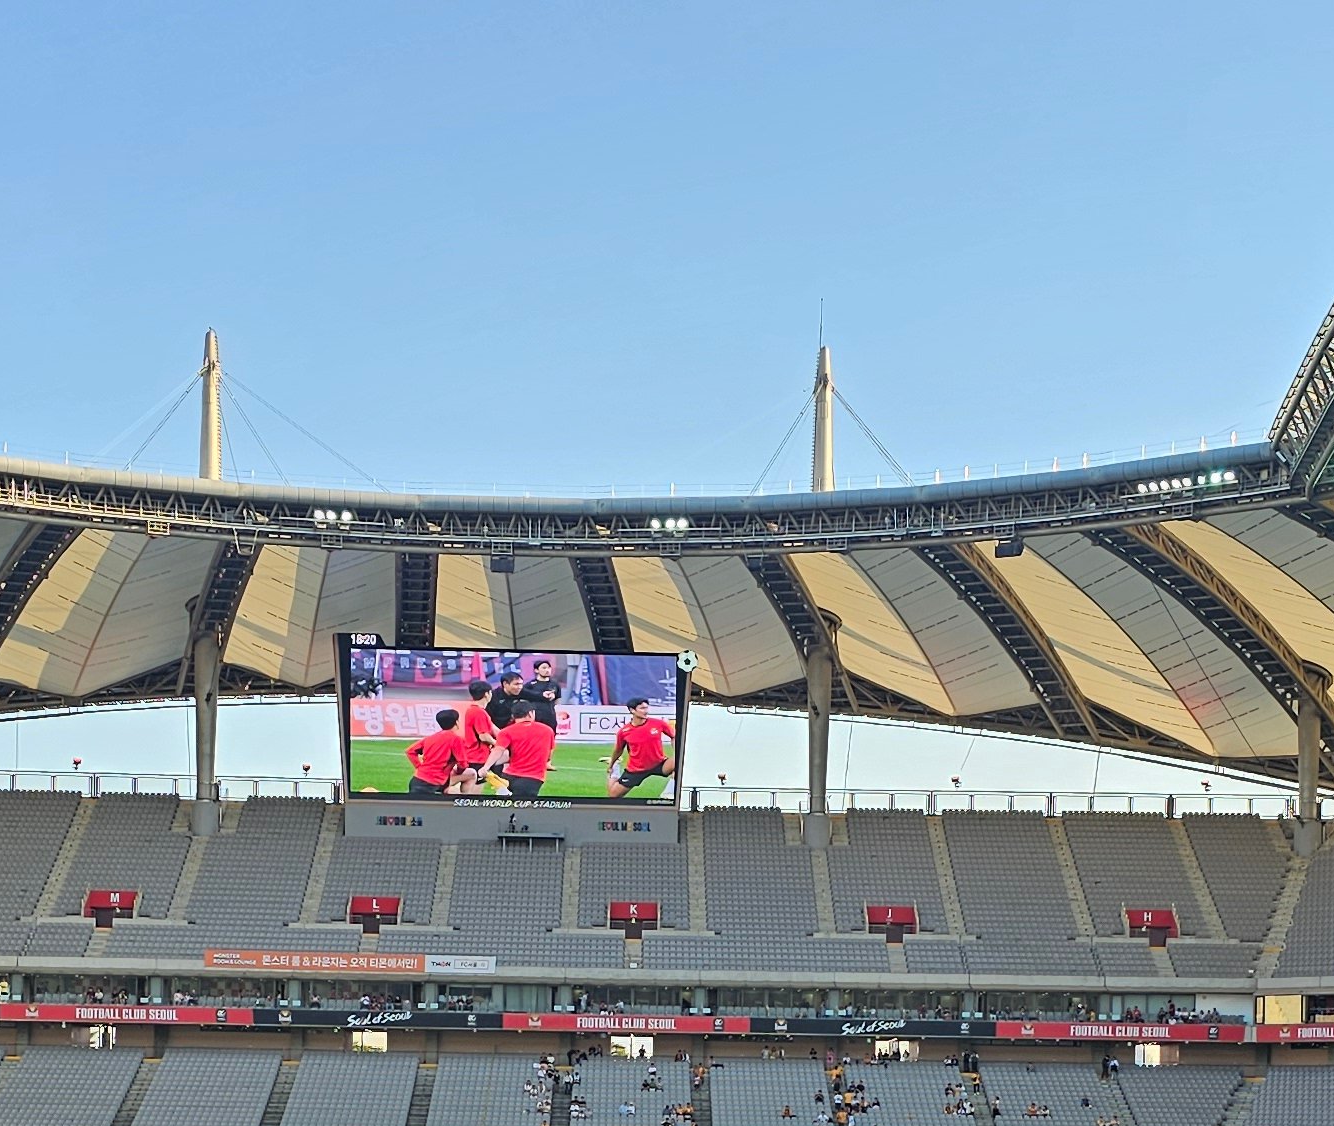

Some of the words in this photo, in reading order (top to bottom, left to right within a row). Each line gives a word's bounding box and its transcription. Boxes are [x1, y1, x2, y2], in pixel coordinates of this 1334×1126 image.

[453, 798, 481, 808] SEOUL
[482, 799, 512, 808] WORLD
[513, 800, 532, 808] CUP
[532, 800, 572, 810] STADIUM
[110, 893, 119, 903] M
[372, 899, 380, 909] L
[630, 903, 638, 914] K
[1144, 912, 1152, 922] H
[75, 1008, 120, 1020] FOOTBALL
[122, 1008, 146, 1020] CLUB
[148, 1008, 179, 1021] SEOUL
[576, 1016, 621, 1029] FOOTBALL
[622, 1017, 646, 1029] CLUB
[647, 1017, 677, 1030] SEOUL
[1070, 1025, 1114, 1037] FOOTBALL
[1115, 1026, 1140, 1038] CLUB
[1141, 1026, 1171, 1038] SEOUL
[1297, 1026, 1334, 1037] FOOTBALL
